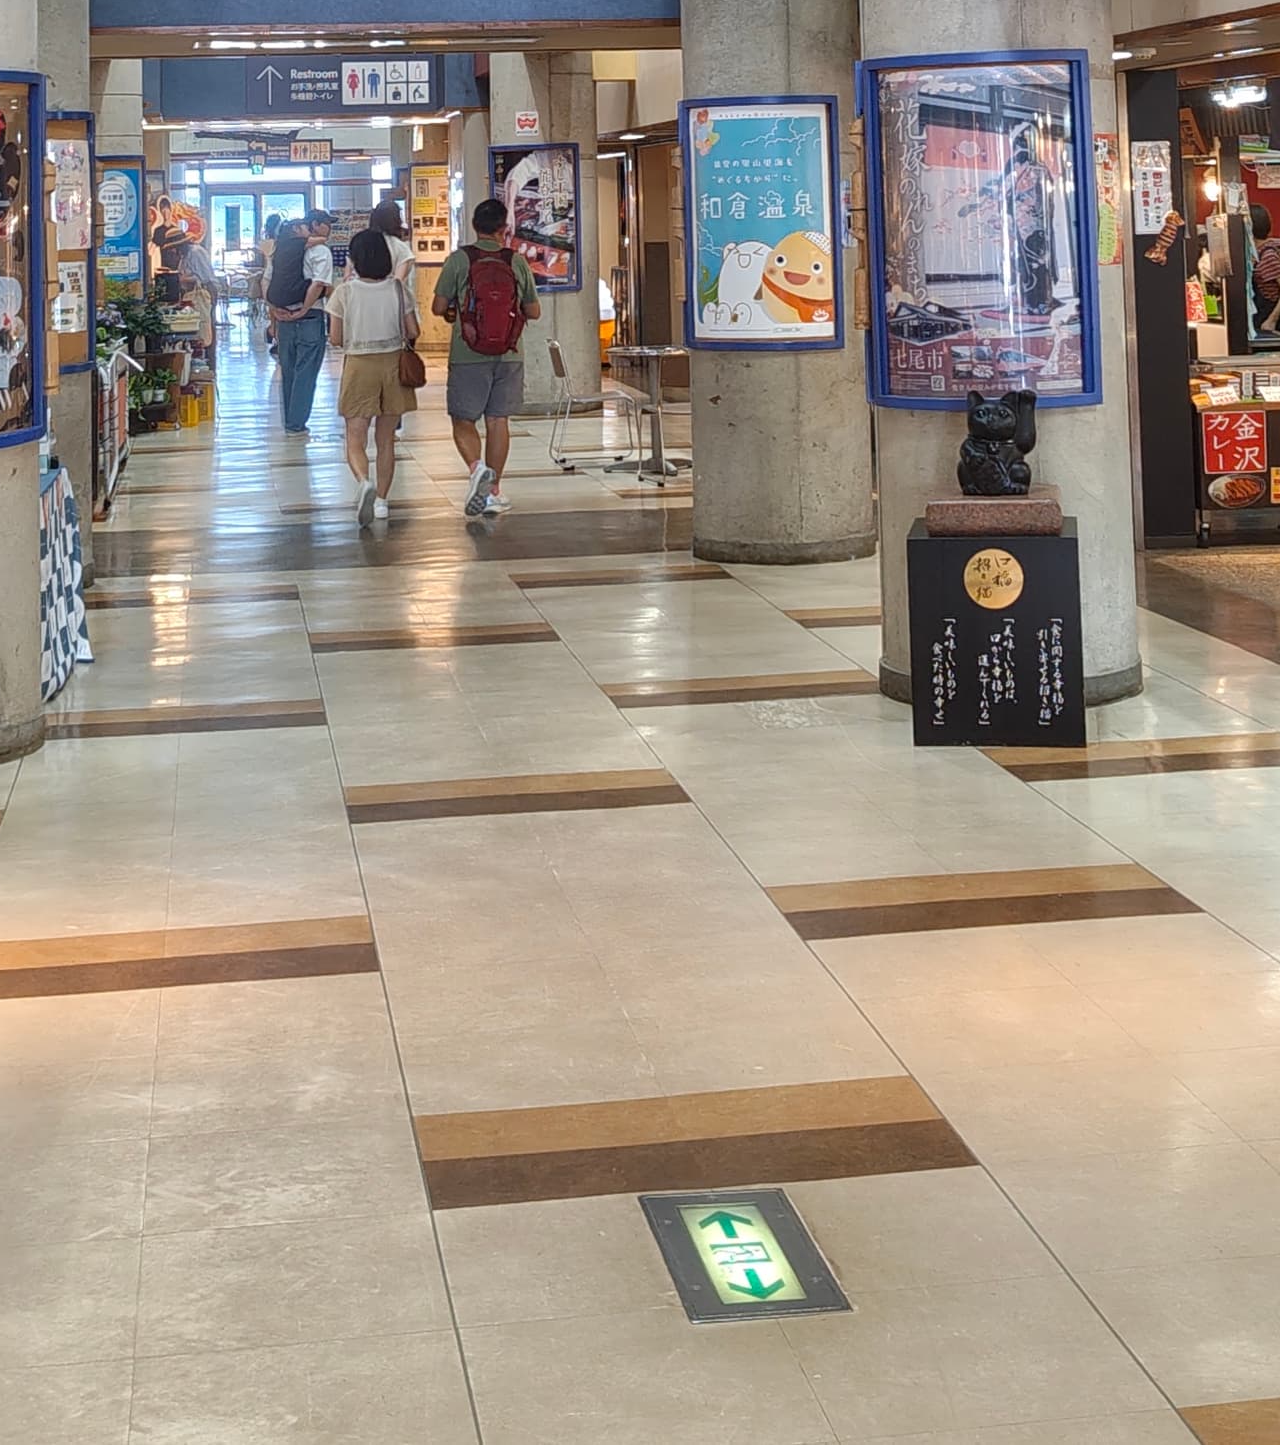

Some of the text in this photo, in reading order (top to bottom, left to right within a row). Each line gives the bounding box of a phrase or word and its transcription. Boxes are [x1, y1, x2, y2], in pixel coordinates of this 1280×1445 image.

[290, 68, 338, 80] Restroom
[700, 190, 814, 219] 和倉温泉
[894, 99, 932, 302] 花嫁のれんのまち
[1207, 415, 1231, 470] カレー
[1232, 414, 1264, 470] 金沢
